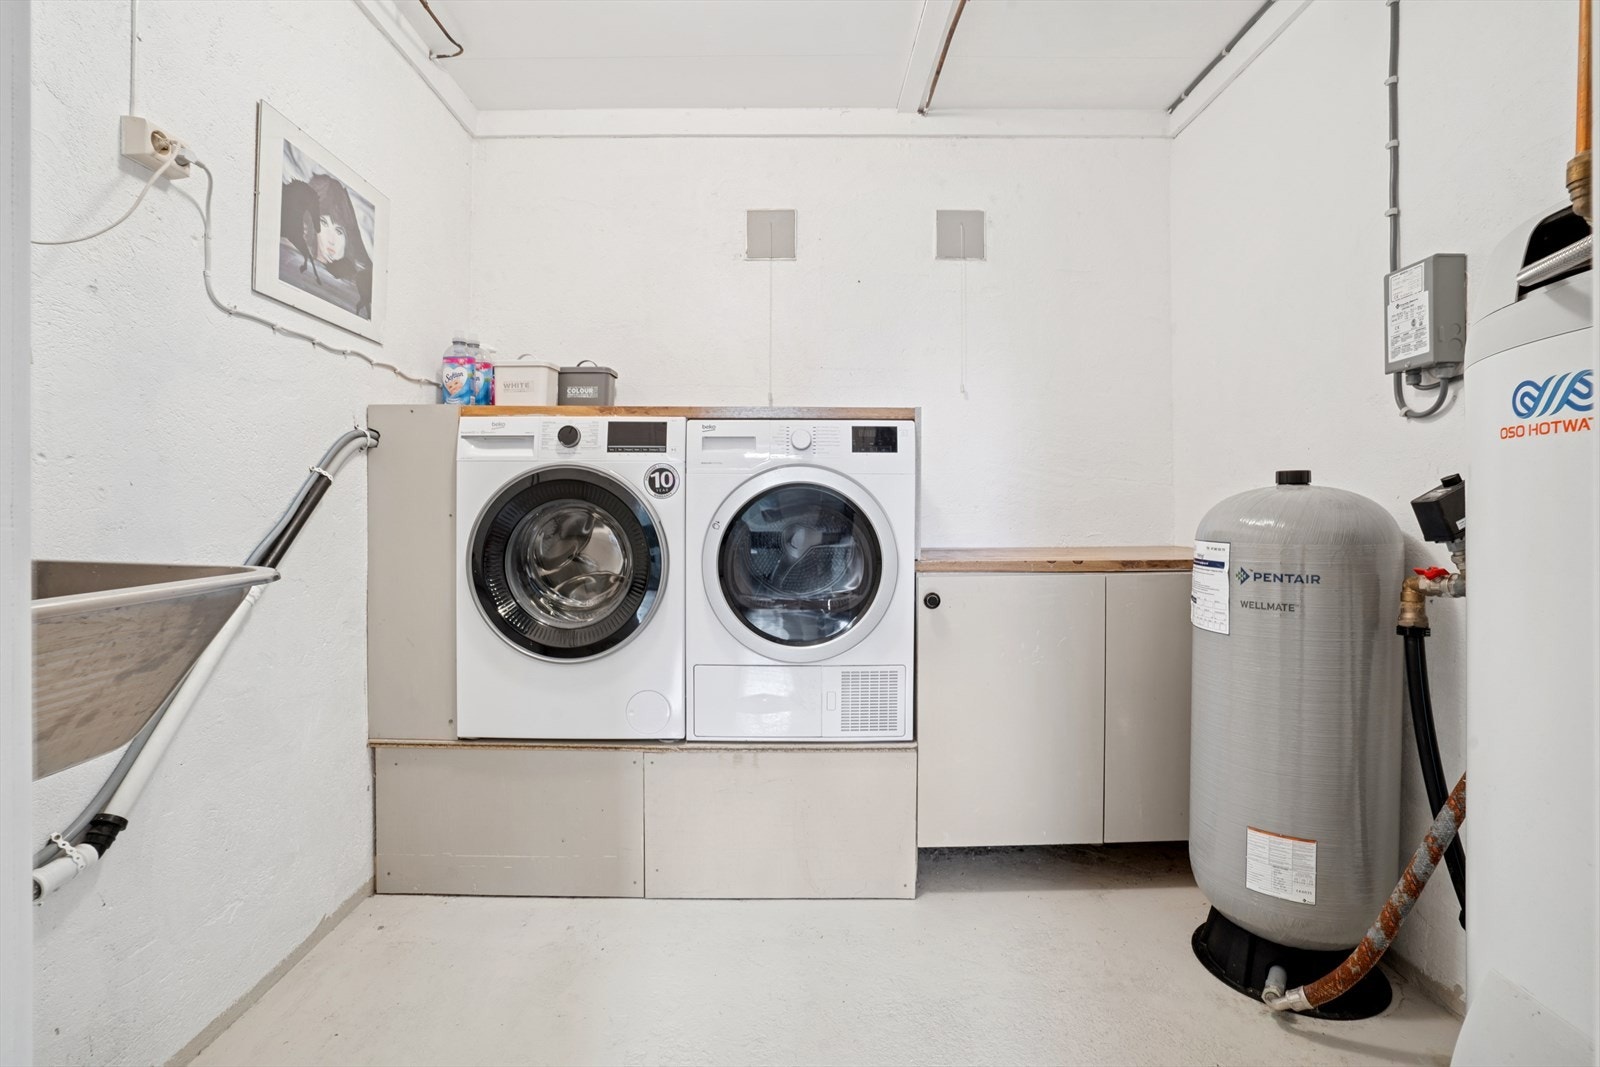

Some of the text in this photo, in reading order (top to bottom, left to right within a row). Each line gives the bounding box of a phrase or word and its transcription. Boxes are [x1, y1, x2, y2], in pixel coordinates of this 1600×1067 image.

[1500, 425, 1525, 440] OSO
[650, 471, 674, 488] 10
[1254, 572, 1321, 584] PENTAIR
[1240, 600, 1295, 612] WELLMATE
